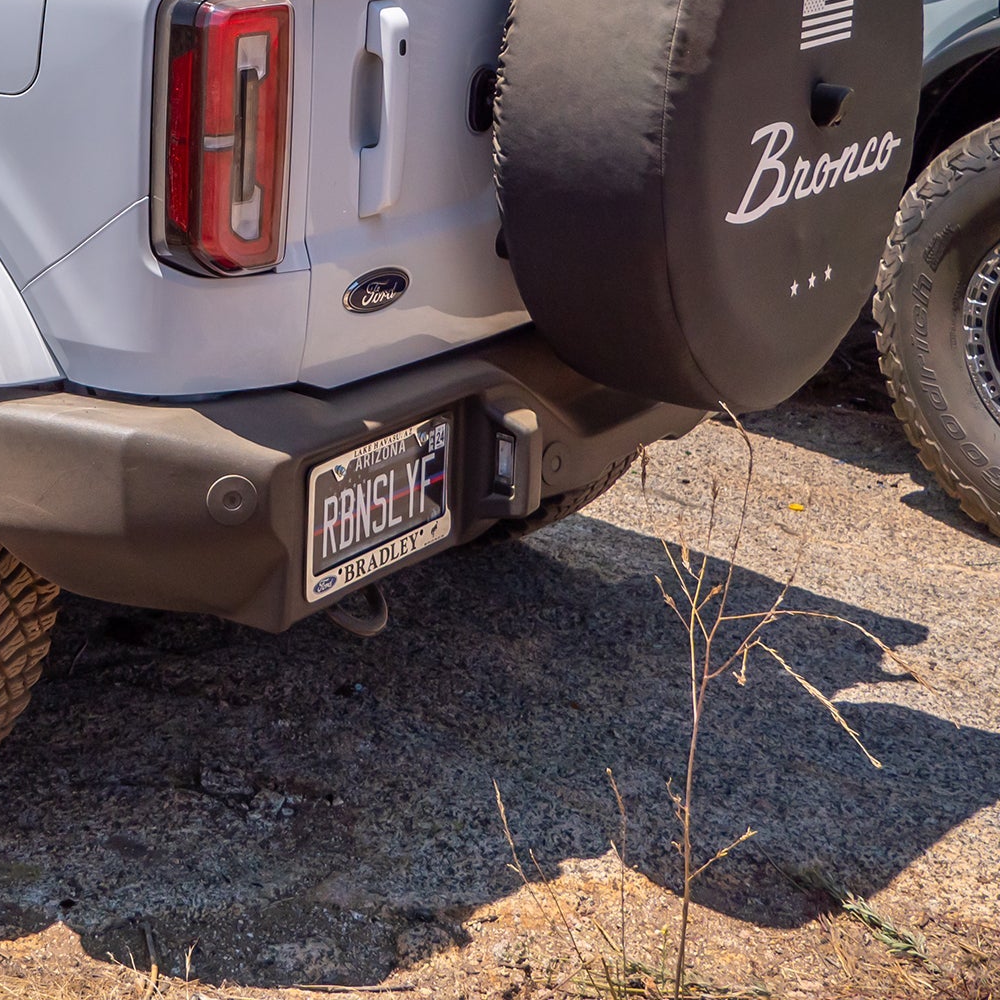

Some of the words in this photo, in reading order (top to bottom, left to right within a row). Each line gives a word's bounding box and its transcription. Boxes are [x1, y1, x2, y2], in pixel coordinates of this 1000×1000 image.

[725, 121, 902, 225] Bronco
[361, 281, 398, 306] Ford
[355, 439, 406, 472] ARIZONA
[344, 532, 418, 584] BRADLEY
